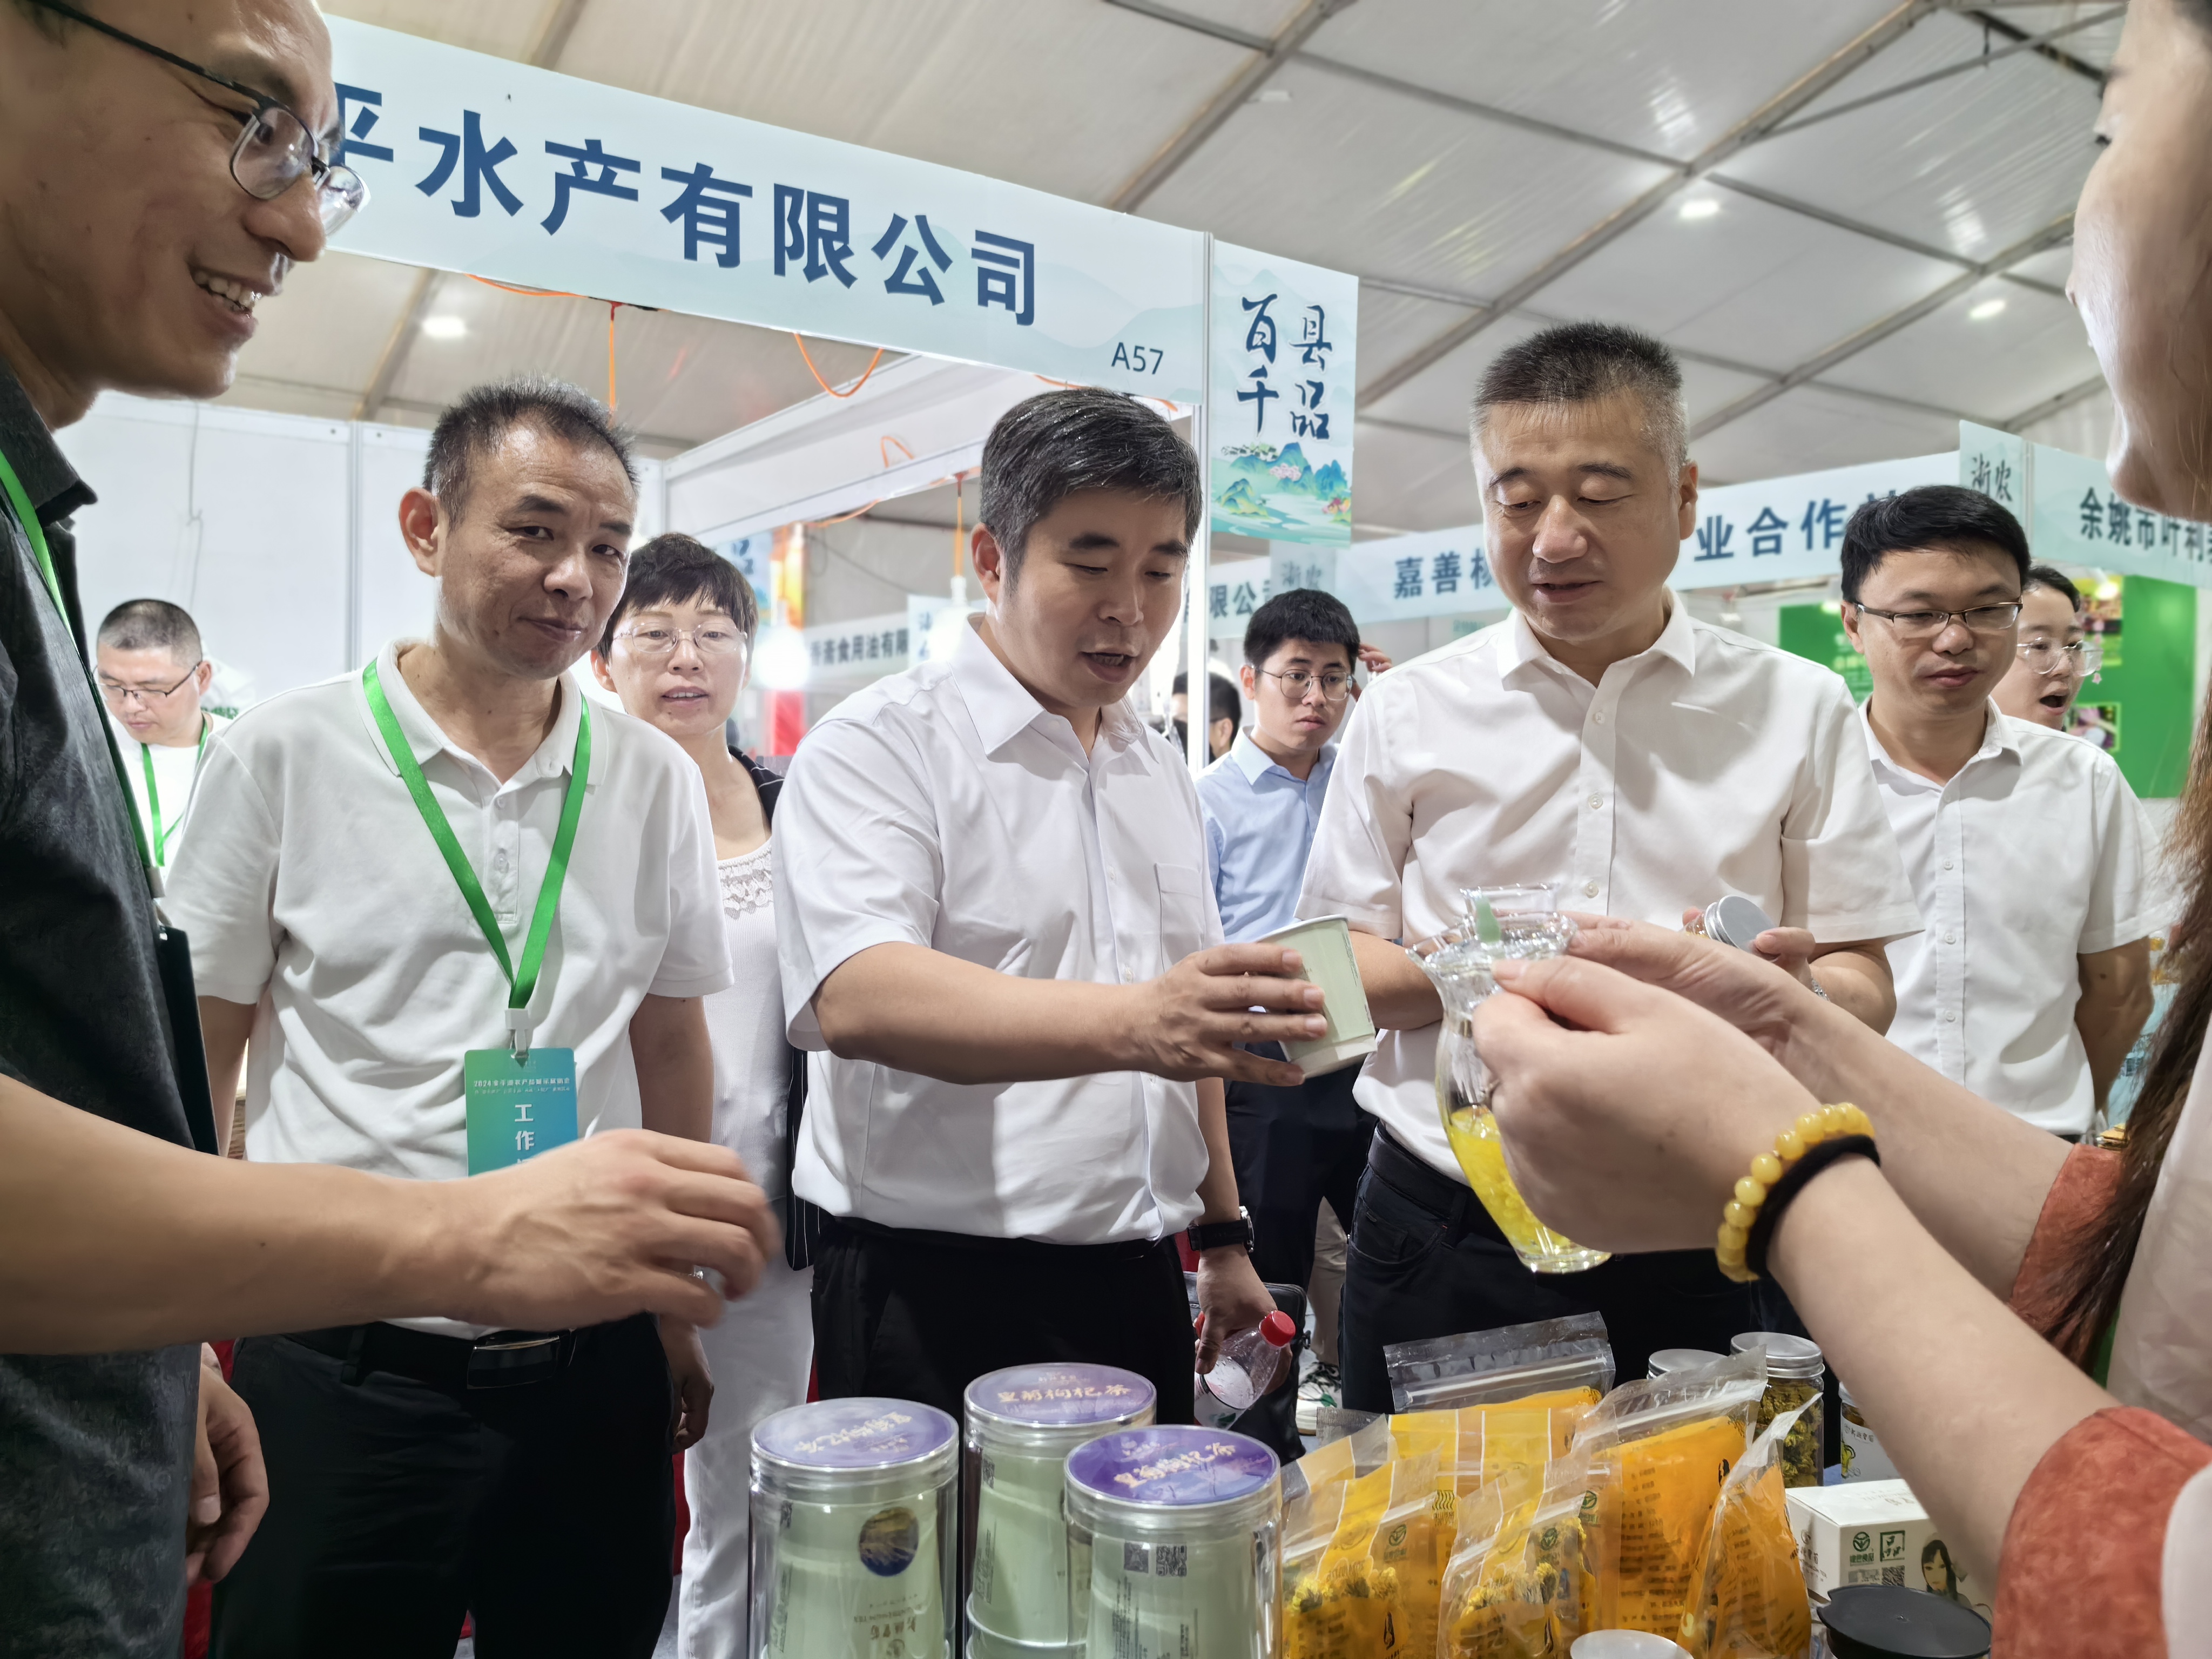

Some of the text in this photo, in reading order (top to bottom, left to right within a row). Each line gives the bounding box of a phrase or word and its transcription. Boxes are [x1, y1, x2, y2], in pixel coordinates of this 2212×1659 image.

[1111, 342, 1163, 375] A57
[1694, 489, 1899, 561] 业合作
[515, 1104, 535, 1163] 工作
